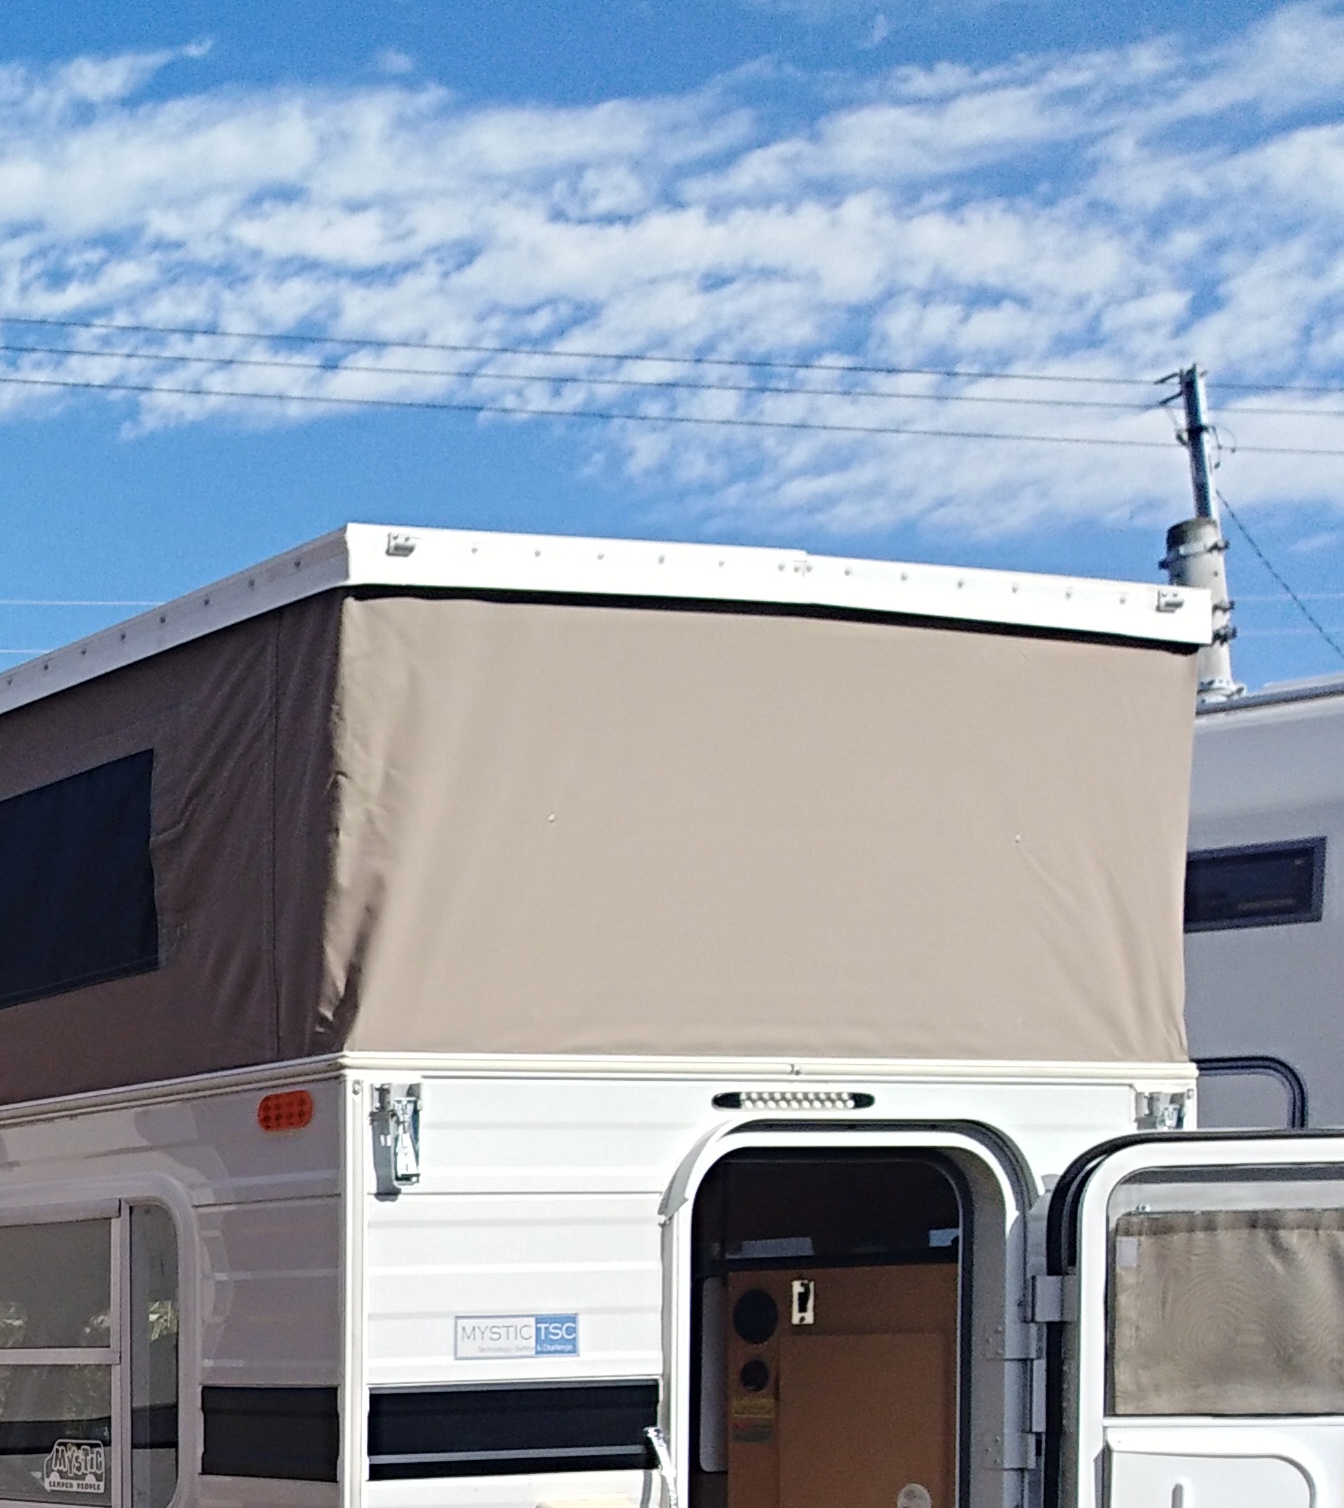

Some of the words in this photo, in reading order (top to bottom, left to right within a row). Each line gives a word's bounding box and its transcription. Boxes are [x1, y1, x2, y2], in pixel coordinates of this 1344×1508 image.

[462, 1325, 532, 1341] MYSTIC
[537, 1323, 576, 1340] TSC
[76, 1482, 101, 1490] PEOPLE
